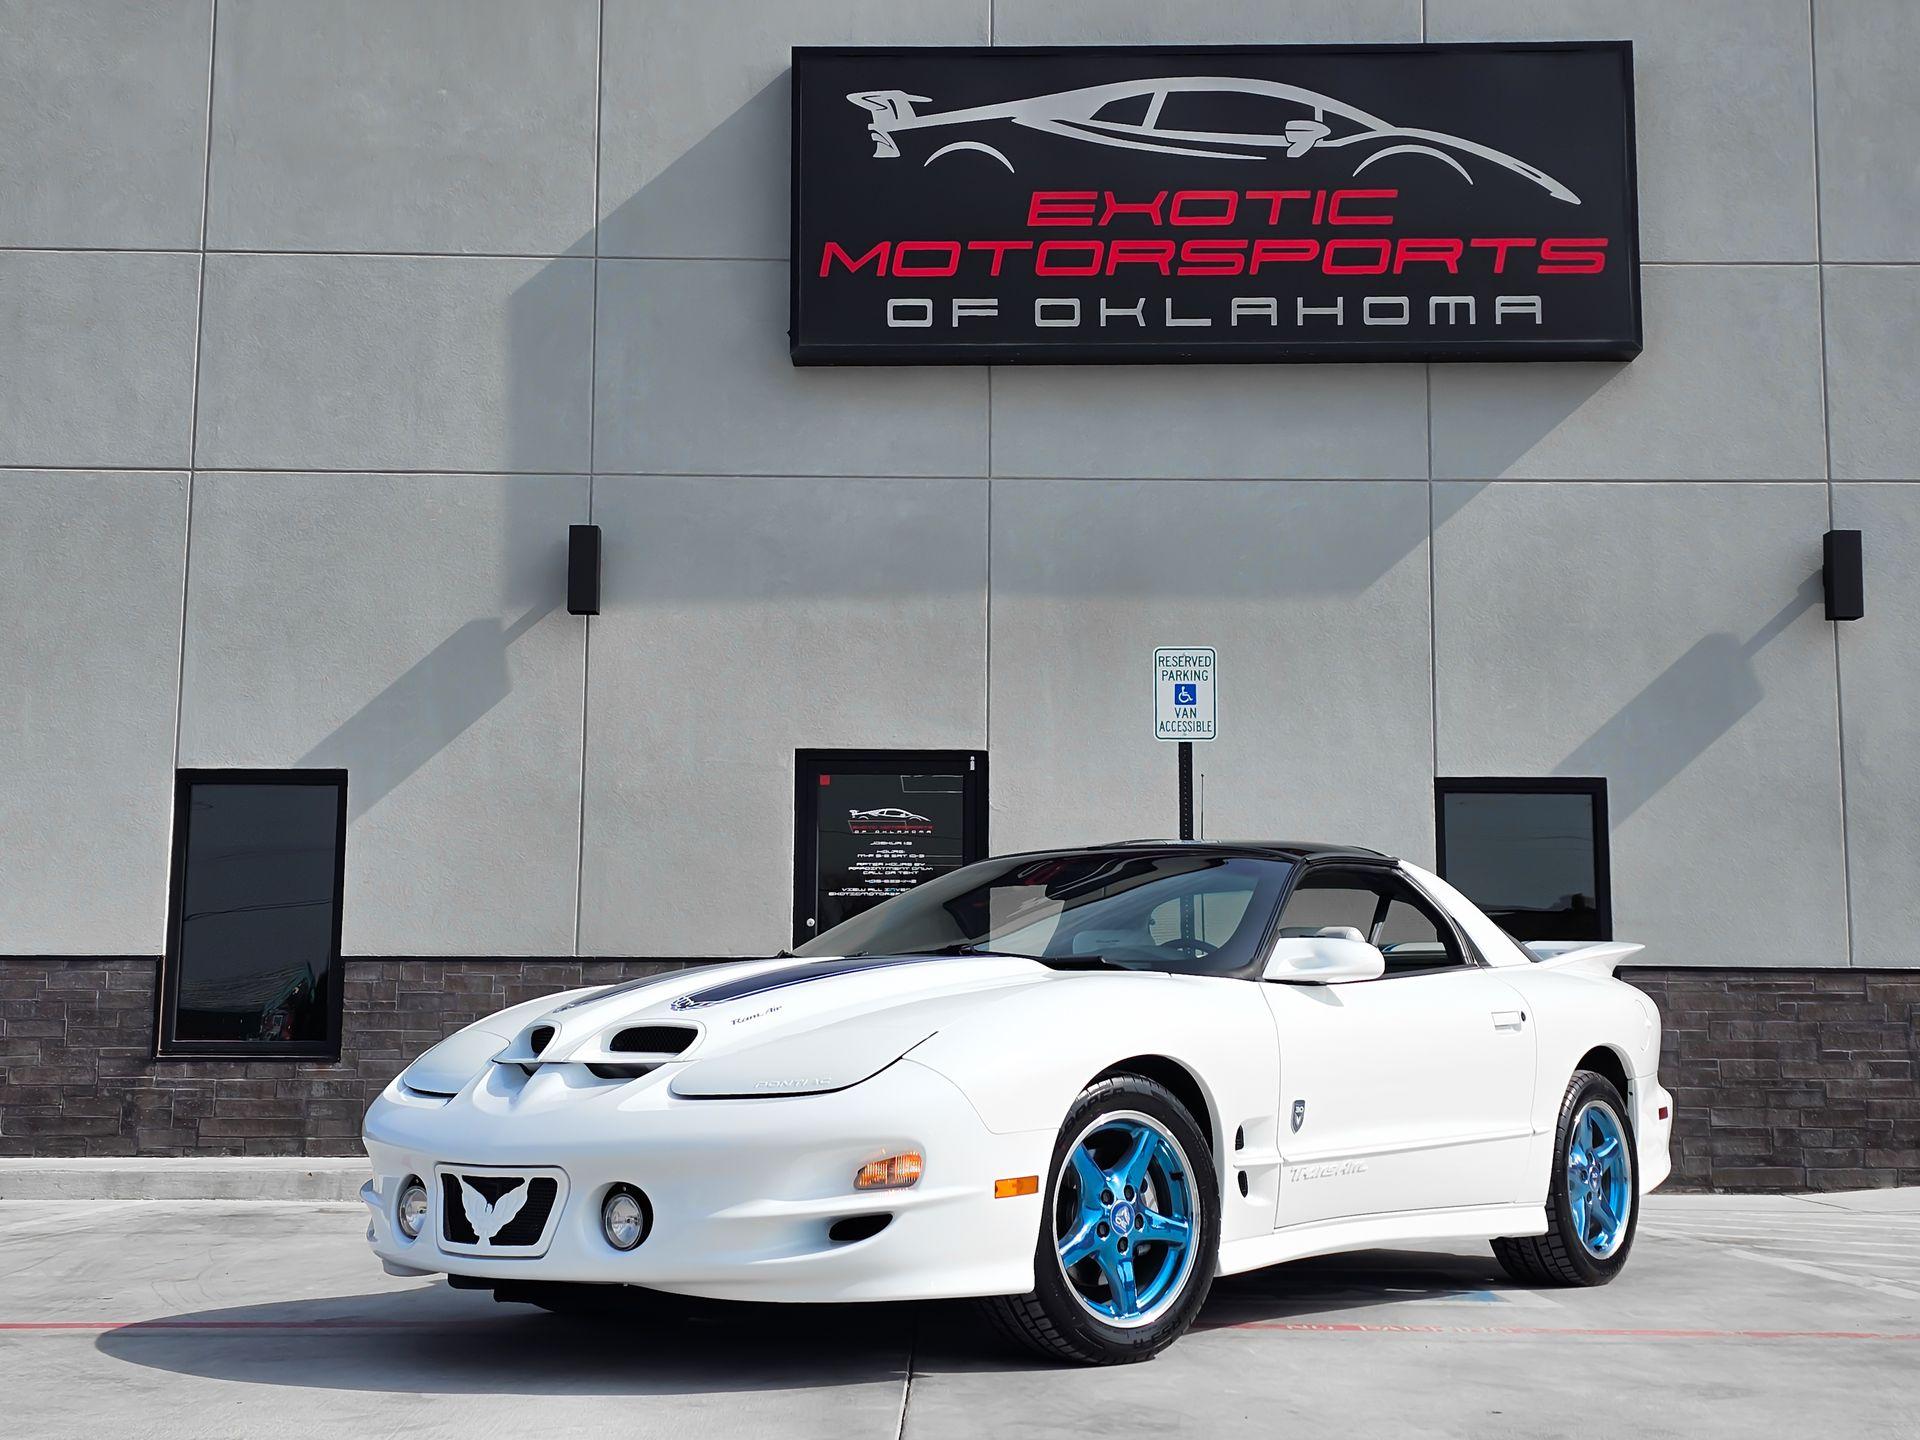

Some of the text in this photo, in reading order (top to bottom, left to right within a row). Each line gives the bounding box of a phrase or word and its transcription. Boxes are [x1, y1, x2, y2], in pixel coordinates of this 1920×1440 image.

[1027, 189, 1399, 228] EXOTIC
[819, 237, 1609, 278] MOTORSPORTS
[886, 295, 1543, 329] OF OKLAHOMA
[1158, 656, 1212, 668] RESERVED
[1161, 670, 1209, 682] PARKING
[1174, 708, 1197, 719] VAN
[1158, 721, 1212, 733] ACCESSIBLE
